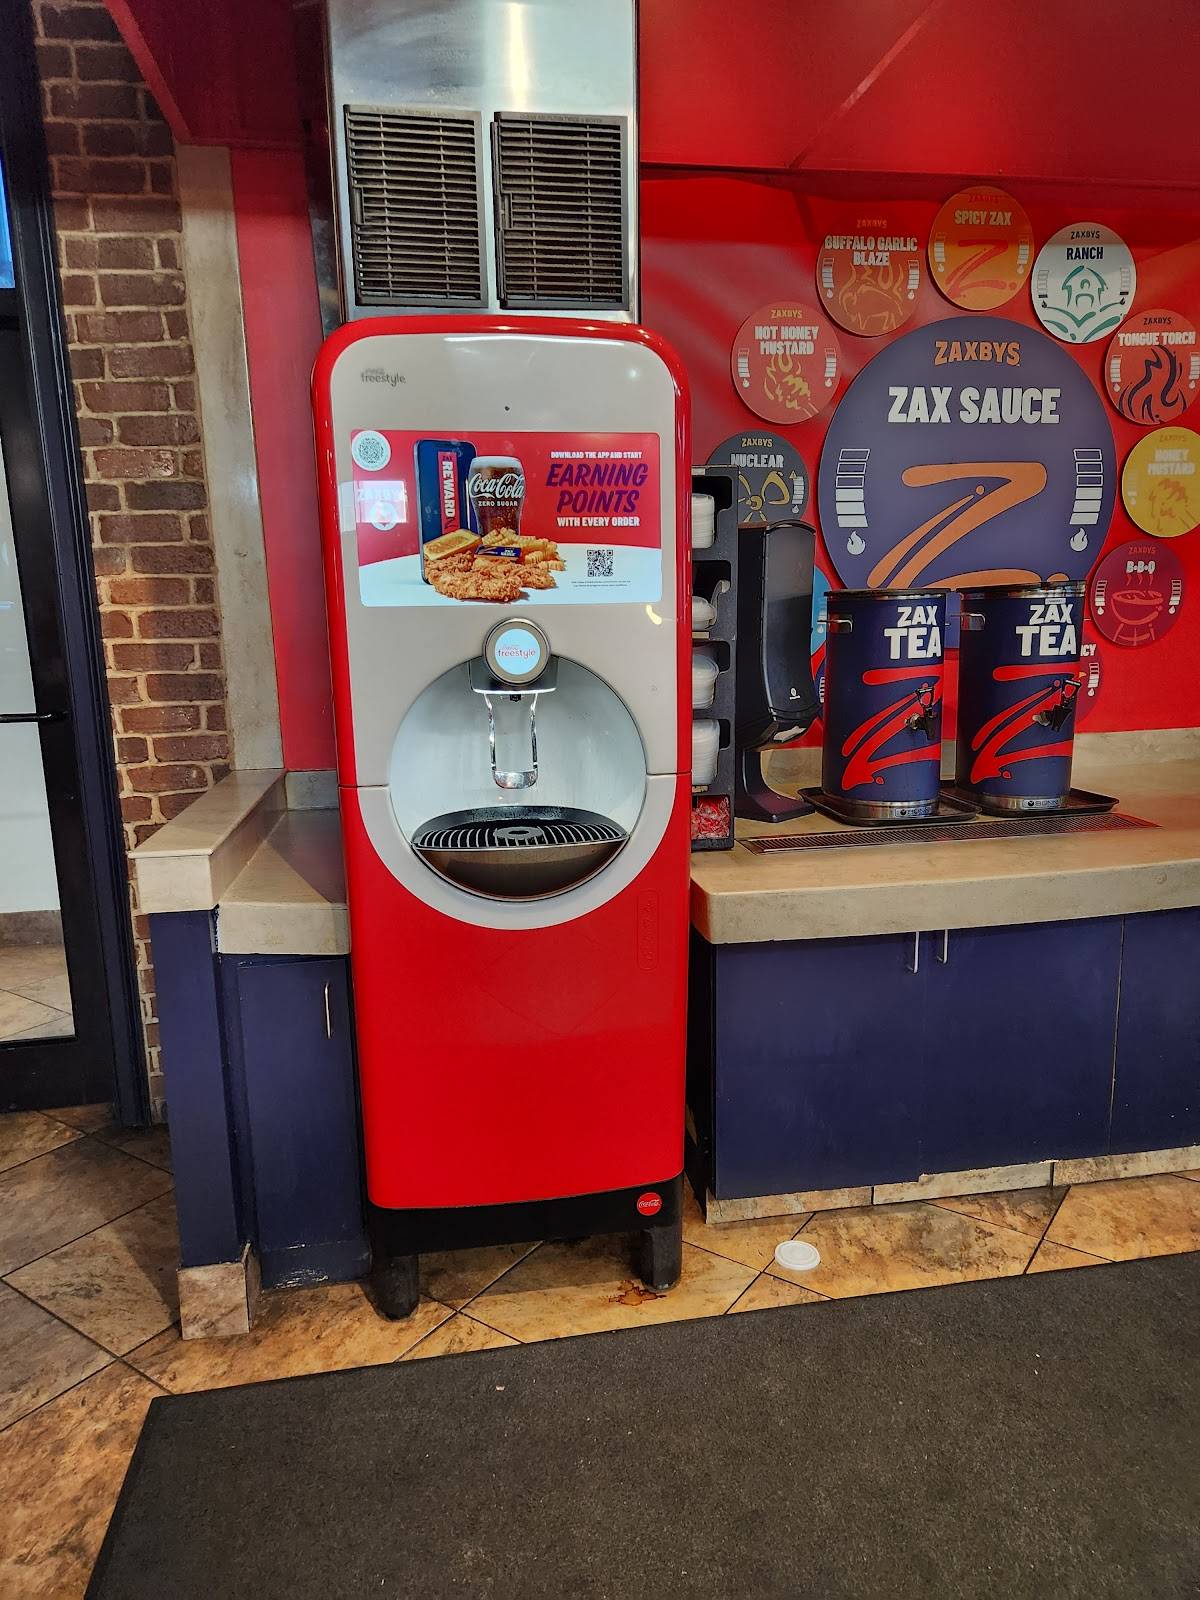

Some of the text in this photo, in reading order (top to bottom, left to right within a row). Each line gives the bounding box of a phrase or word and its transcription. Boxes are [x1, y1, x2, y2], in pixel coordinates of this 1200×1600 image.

[954, 210, 1012, 226] SPICY ZAX
[1070, 230, 1101, 240] ZAXBYS
[824, 234, 918, 252] BUFFALO GARLIC
[853, 251, 890, 266] BLAZE
[1066, 246, 1104, 260] RANCH
[770, 309, 803, 319] ZAXBYS
[1143, 316, 1172, 326] ZAXBYS
[754, 325, 820, 340] HOT HONEY
[1117, 331, 1196, 347] TONGUE TORCH
[760, 340, 815, 355] MUSTARD
[934, 340, 1021, 367] ZAXBYS
[360, 371, 407, 388] freestyle
[887, 386, 1061, 424] ZAX SAUCE
[741, 437, 773, 448] ZAXBYS
[550, 451, 642, 459] DOWNLOAD THE APP AND START
[730, 453, 785, 468] NUCLEAR
[546, 463, 649, 487] EARNING
[442, 461, 456, 518] REWARD
[557, 489, 640, 513] POINTS
[557, 516, 640, 527] WITH EVERY ORDER
[897, 605, 938, 628] ZAX
[1029, 603, 1074, 625] ZAX
[884, 626, 942, 660] TEA
[1015, 624, 1077, 657] TEA
[498, 648, 536, 660] freestyle
[1080, 643, 1097, 657] ICY
